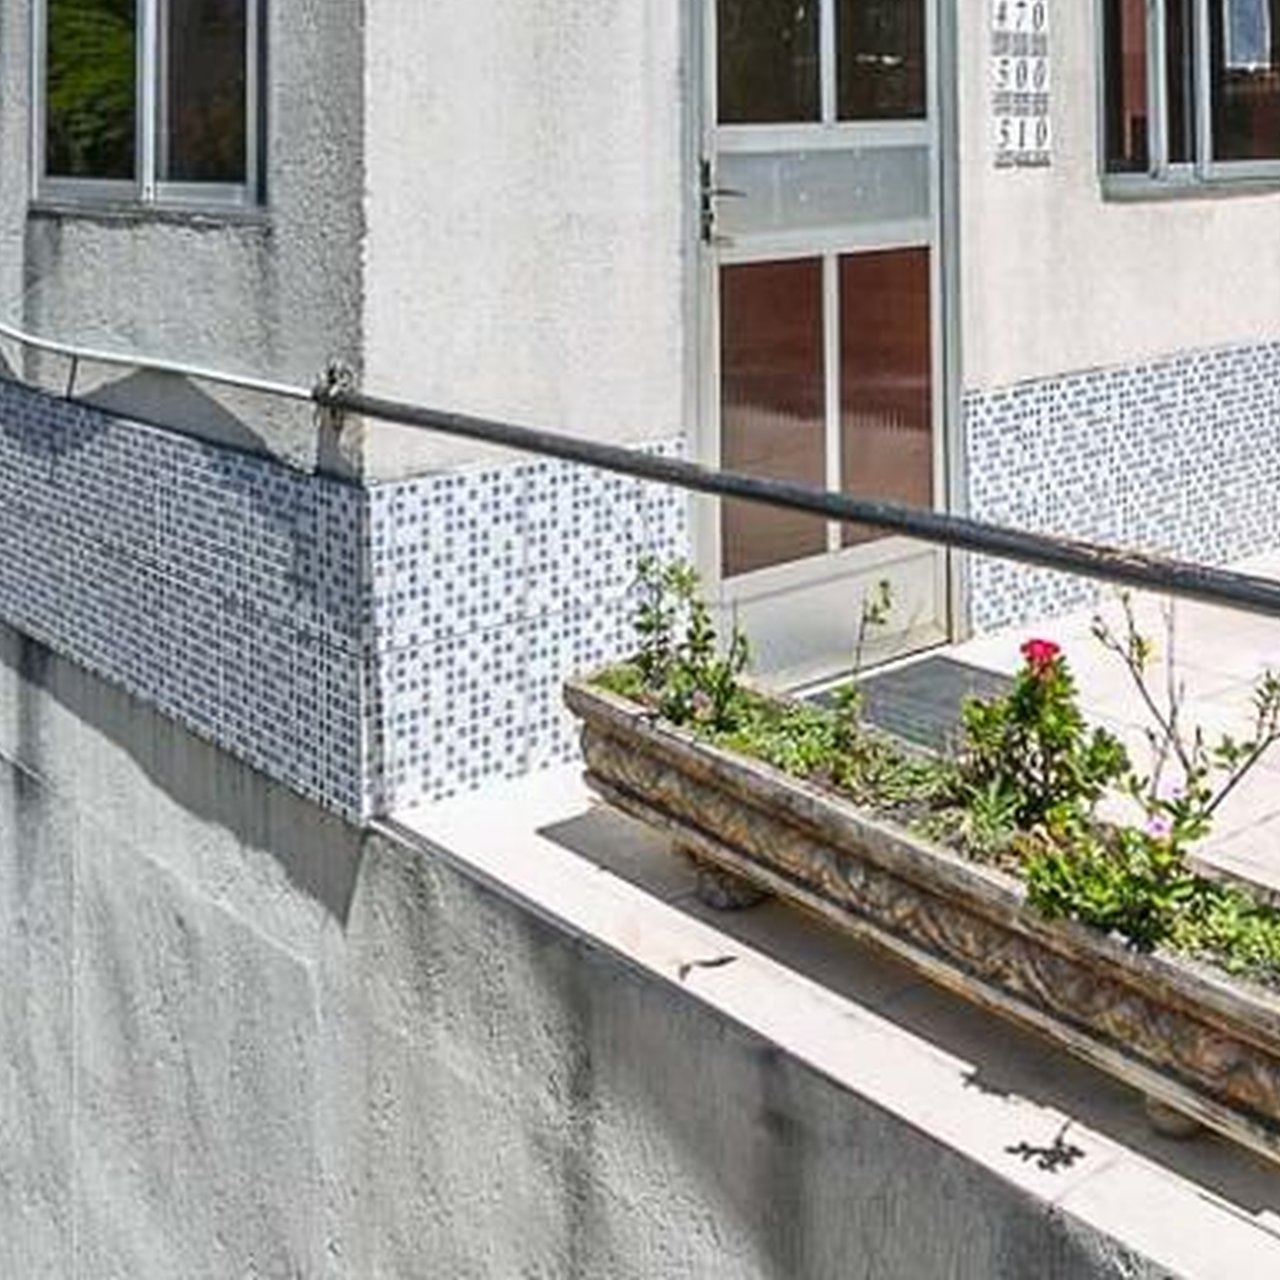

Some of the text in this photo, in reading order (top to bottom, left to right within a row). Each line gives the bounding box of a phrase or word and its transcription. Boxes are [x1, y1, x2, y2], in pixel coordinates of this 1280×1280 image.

[997, 0, 1045, 30] 470
[997, 58, 1046, 88] 500
[998, 119, 1048, 150] 510
